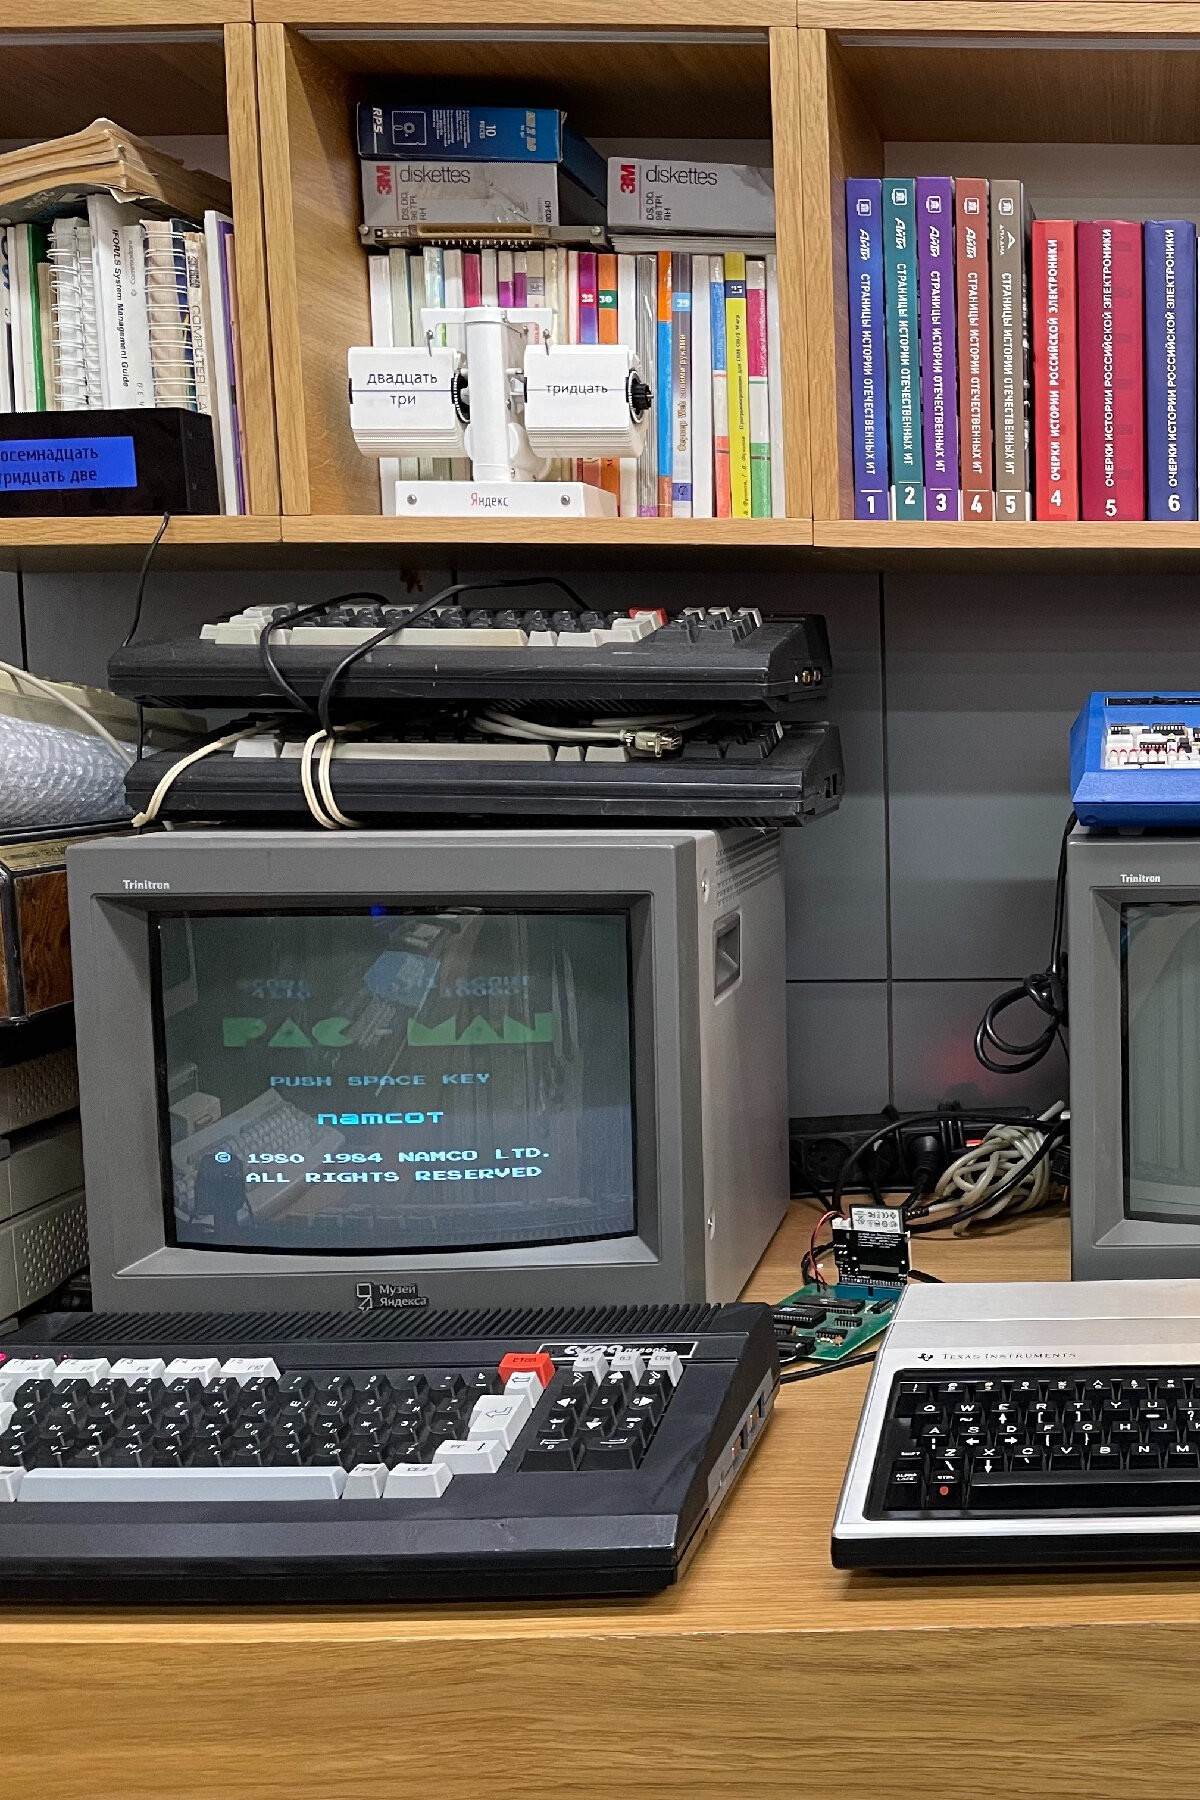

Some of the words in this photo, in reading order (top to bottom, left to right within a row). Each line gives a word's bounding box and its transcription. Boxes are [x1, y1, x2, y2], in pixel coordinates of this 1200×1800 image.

[372, 107, 384, 134] RPS
[376, 165, 392, 195] 3M
[400, 165, 471, 184] diskettes
[620, 164, 636, 194] 3M
[645, 164, 718, 186] diskettes
[1047, 240, 1058, 314] ЭЛЕКТРОНИКИ
[1102, 228, 1112, 309] ЭЛЕКТРОНИКИ
[1164, 229, 1175, 309] ЭЛЕКТРОНИКИ
[113, 267, 123, 301] System
[896, 263, 908, 317] СТРАНИЦЫ
[930, 270, 941, 324] СТРАНИЦЫ
[967, 272, 979, 326] СТРАНИЦЫ
[860, 273, 871, 327] СТРАНИЦЫ
[1001, 273, 1012, 327] СТРАНИЦЫ
[115, 303, 128, 359] Management
[191, 305, 206, 384] COMPUTER
[898, 320, 909, 365] ИСТОРИИ
[679, 334, 689, 365] руками
[861, 330, 872, 375] ИСТОРИИ
[932, 327, 943, 373] ИСТОРИИ
[969, 329, 980, 374] ИСТОРИИ
[1003, 329, 1013, 374] ИСТОРИИ
[1048, 317, 1059, 387] РОССИЙСКОЙ
[1103, 311, 1113, 387] РОССИЙСКОЙ
[1166, 311, 1176, 387] РОССИЙСКОЙ
[120, 361, 130, 388] Guide
[367, 372, 438, 385] двадцать
[546, 383, 608, 396] тридцать
[390, 394, 416, 408] три
[900, 368, 912, 450] ОТЕЧЕСТВЕННЫХ
[933, 375, 945, 457] ОТЕЧЕСТВЕННЫХ
[1049, 391, 1060, 437] ИСТОРИИ
[1104, 391, 1114, 441] ИСТОРИИ
[1167, 391, 1177, 441] ИСТОРИИ
[863, 378, 874, 459] ОТЕЧЕСТВЕННЫХ
[970, 376, 982, 458] ОТЕЧЕСТВЕННЫХ
[1003, 377, 1014, 459] ОТЕЧЕСТВЕННЫХ
[678, 421, 689, 452] Сервер
[0, 447, 98, 462] осемнадцать
[866, 462, 876, 475] ИТ
[903, 453, 913, 465] ИТ
[935, 460, 945, 473] ИТ
[972, 461, 982, 474] ИТ
[1005, 462, 1015, 474] ИТ
[1050, 441, 1061, 481] ОЧЕРКИ
[1104, 444, 1115, 487] ОЧЕРКИ
[1168, 444, 1178, 487] ОЧЕРКИ
[70, 469, 97, 483] две
[470, 492, 509, 507] Яндекс
[866, 496, 875, 514] 1
[904, 487, 915, 504] 2
[935, 494, 947, 511] 3
[971, 495, 983, 513] 4
[1005, 496, 1016, 514] 5
[1050, 489, 1062, 507] 4
[1105, 499, 1117, 517] 5
[1168, 494, 1181, 512] 6
[122, 880, 170, 890] Trinitron
[1120, 874, 1161, 884] Trinitron
[222, 1011, 556, 1048] PAC-MAN
[270, 1075, 332, 1087] PUSH
[347, 1074, 427, 1087] SPACE
[442, 1073, 491, 1085] KEY
[318, 1111, 444, 1125] namcot
[247, 1153, 305, 1164] 1980
[323, 1153, 383, 1163] 1984
[398, 1150, 478, 1163] NAMCO
[495, 1147, 550, 1160] LTD.
[246, 1172, 290, 1183] ALL
[305, 1171, 400, 1183] RIGHTS
[415, 1167, 542, 1182] RESERVED
[380, 1284, 416, 1296] Музей
[380, 1297, 427, 1307] Яндекса
